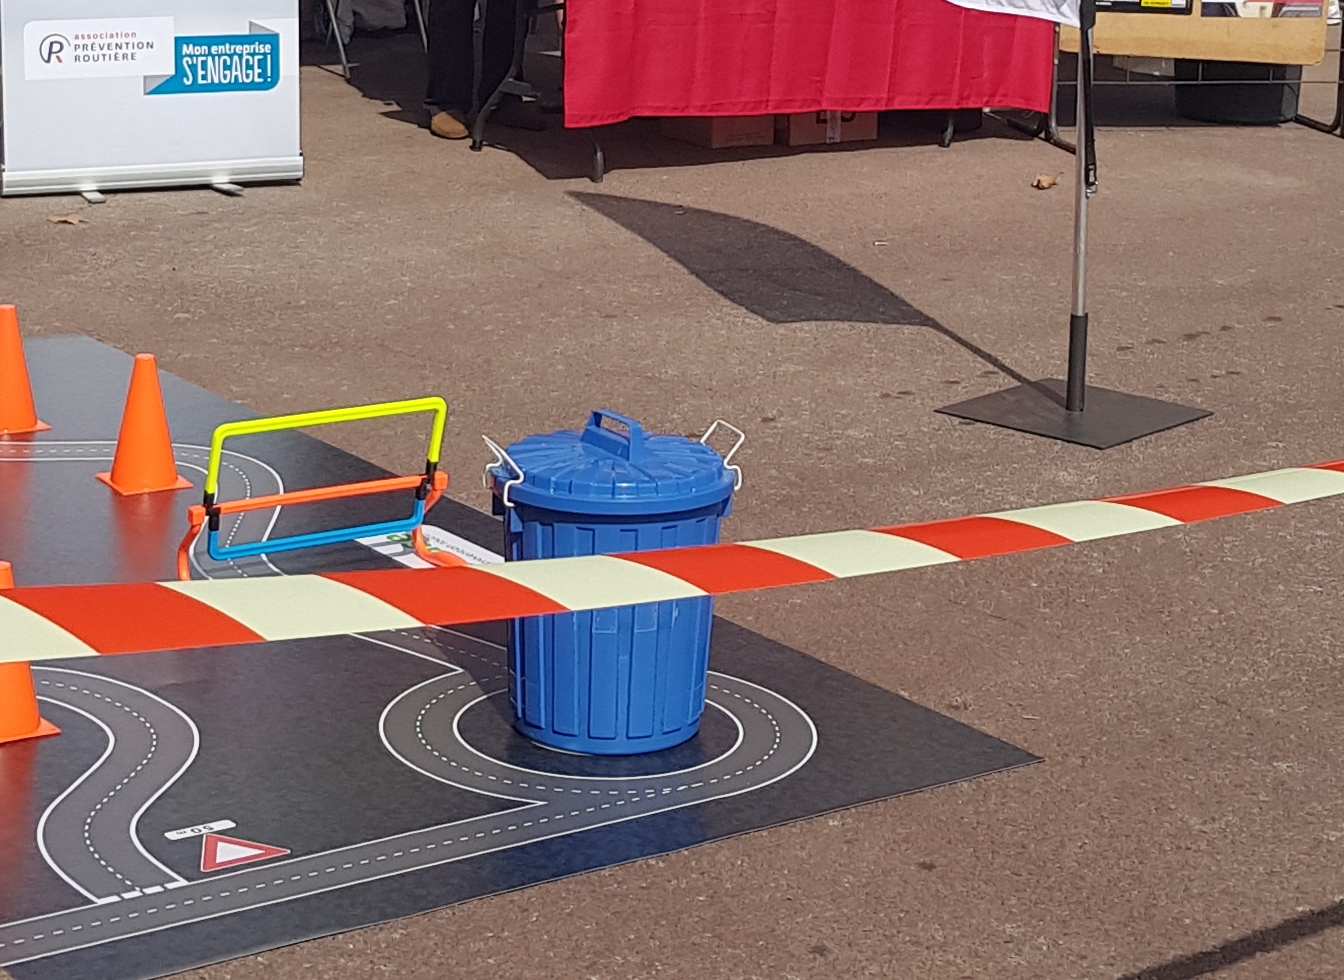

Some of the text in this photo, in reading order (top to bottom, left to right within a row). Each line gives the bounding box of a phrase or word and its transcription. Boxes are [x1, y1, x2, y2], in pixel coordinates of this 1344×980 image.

[74, 30, 136, 40] association
[74, 40, 154, 52] PRÉVENTION
[182, 41, 272, 56] Mon entreprise
[74, 50, 137, 63] ROUTIÈRE
